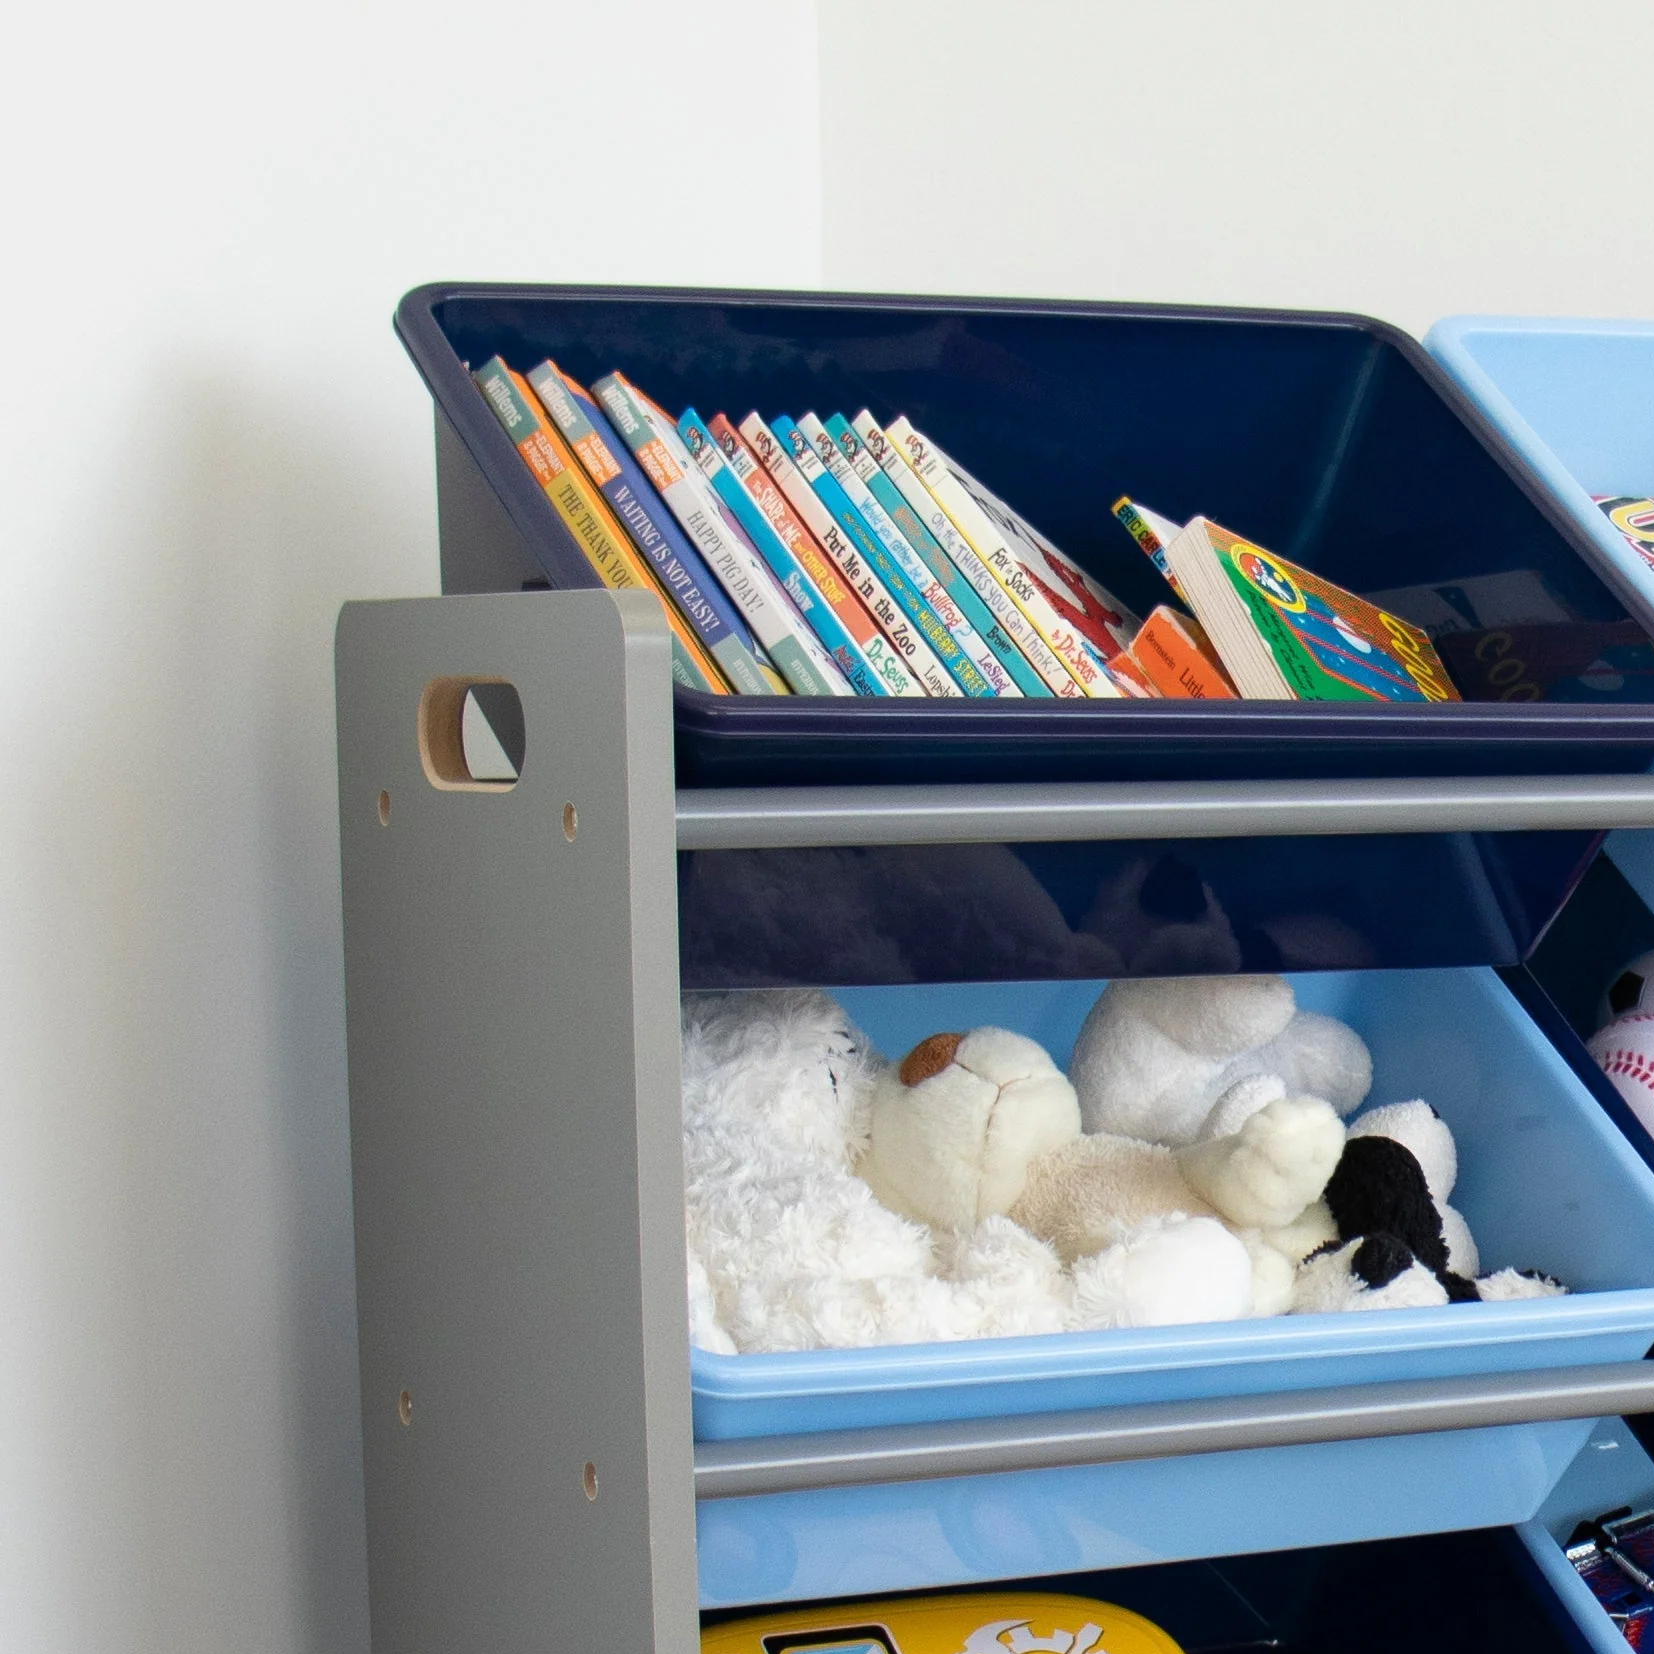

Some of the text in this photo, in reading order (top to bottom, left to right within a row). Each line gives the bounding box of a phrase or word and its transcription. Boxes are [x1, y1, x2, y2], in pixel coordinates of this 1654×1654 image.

[485, 375, 522, 428] Willems
[539, 377, 577, 429] Willems
[601, 384, 639, 435] Willems
[559, 484, 634, 590] THE THANK YOU
[859, 497, 881, 530] Would
[1116, 503, 1167, 570] ERIC CARLE
[614, 486, 721, 632] WAITING IS NOT EASY!
[687, 510, 765, 613] HAPPY PIG DAY!
[758, 487, 787, 526] SHAPE
[781, 520, 802, 548] ME
[802, 551, 828, 584] OTHER
[820, 575, 846, 603] STUFF
[783, 571, 815, 612] Snow
[824, 526, 916, 657] Put Me in the Zoo
[988, 548, 1012, 572] Fox
[1005, 571, 1037, 602] Socks
[917, 610, 959, 658] MULBERRY
[954, 544, 992, 591] THINKS
[985, 585, 1007, 613] you
[1005, 610, 1024, 636] Can
[1023, 631, 1062, 675] Think!
[883, 655, 909, 695] Seuss
[976, 653, 1011, 698] LeSieg
[1054, 634, 1075, 659] Dr.
[1071, 651, 1098, 684] Seuss
[1145, 630, 1176, 672] Bornstein
